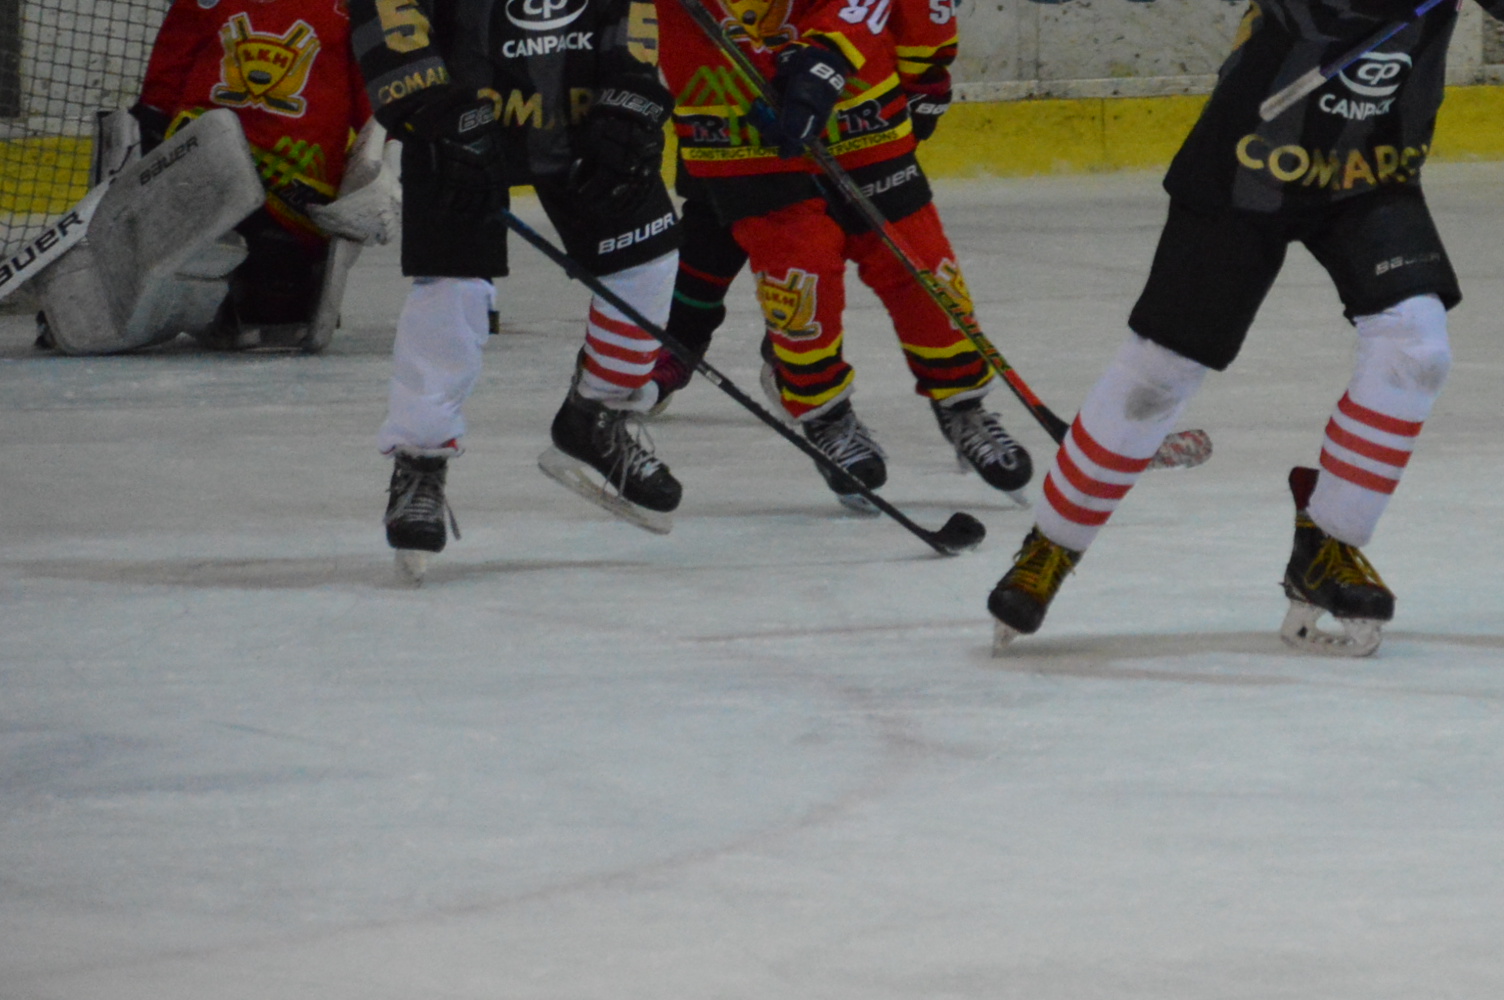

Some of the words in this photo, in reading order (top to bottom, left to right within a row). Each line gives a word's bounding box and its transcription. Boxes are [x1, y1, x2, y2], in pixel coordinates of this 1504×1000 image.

[502, 32, 594, 58] CANPACK
[139, 136, 199, 186] BAUER
[862, 165, 919, 197] AUER
[0, 211, 84, 287] AUER
[598, 212, 676, 255] BAUER
